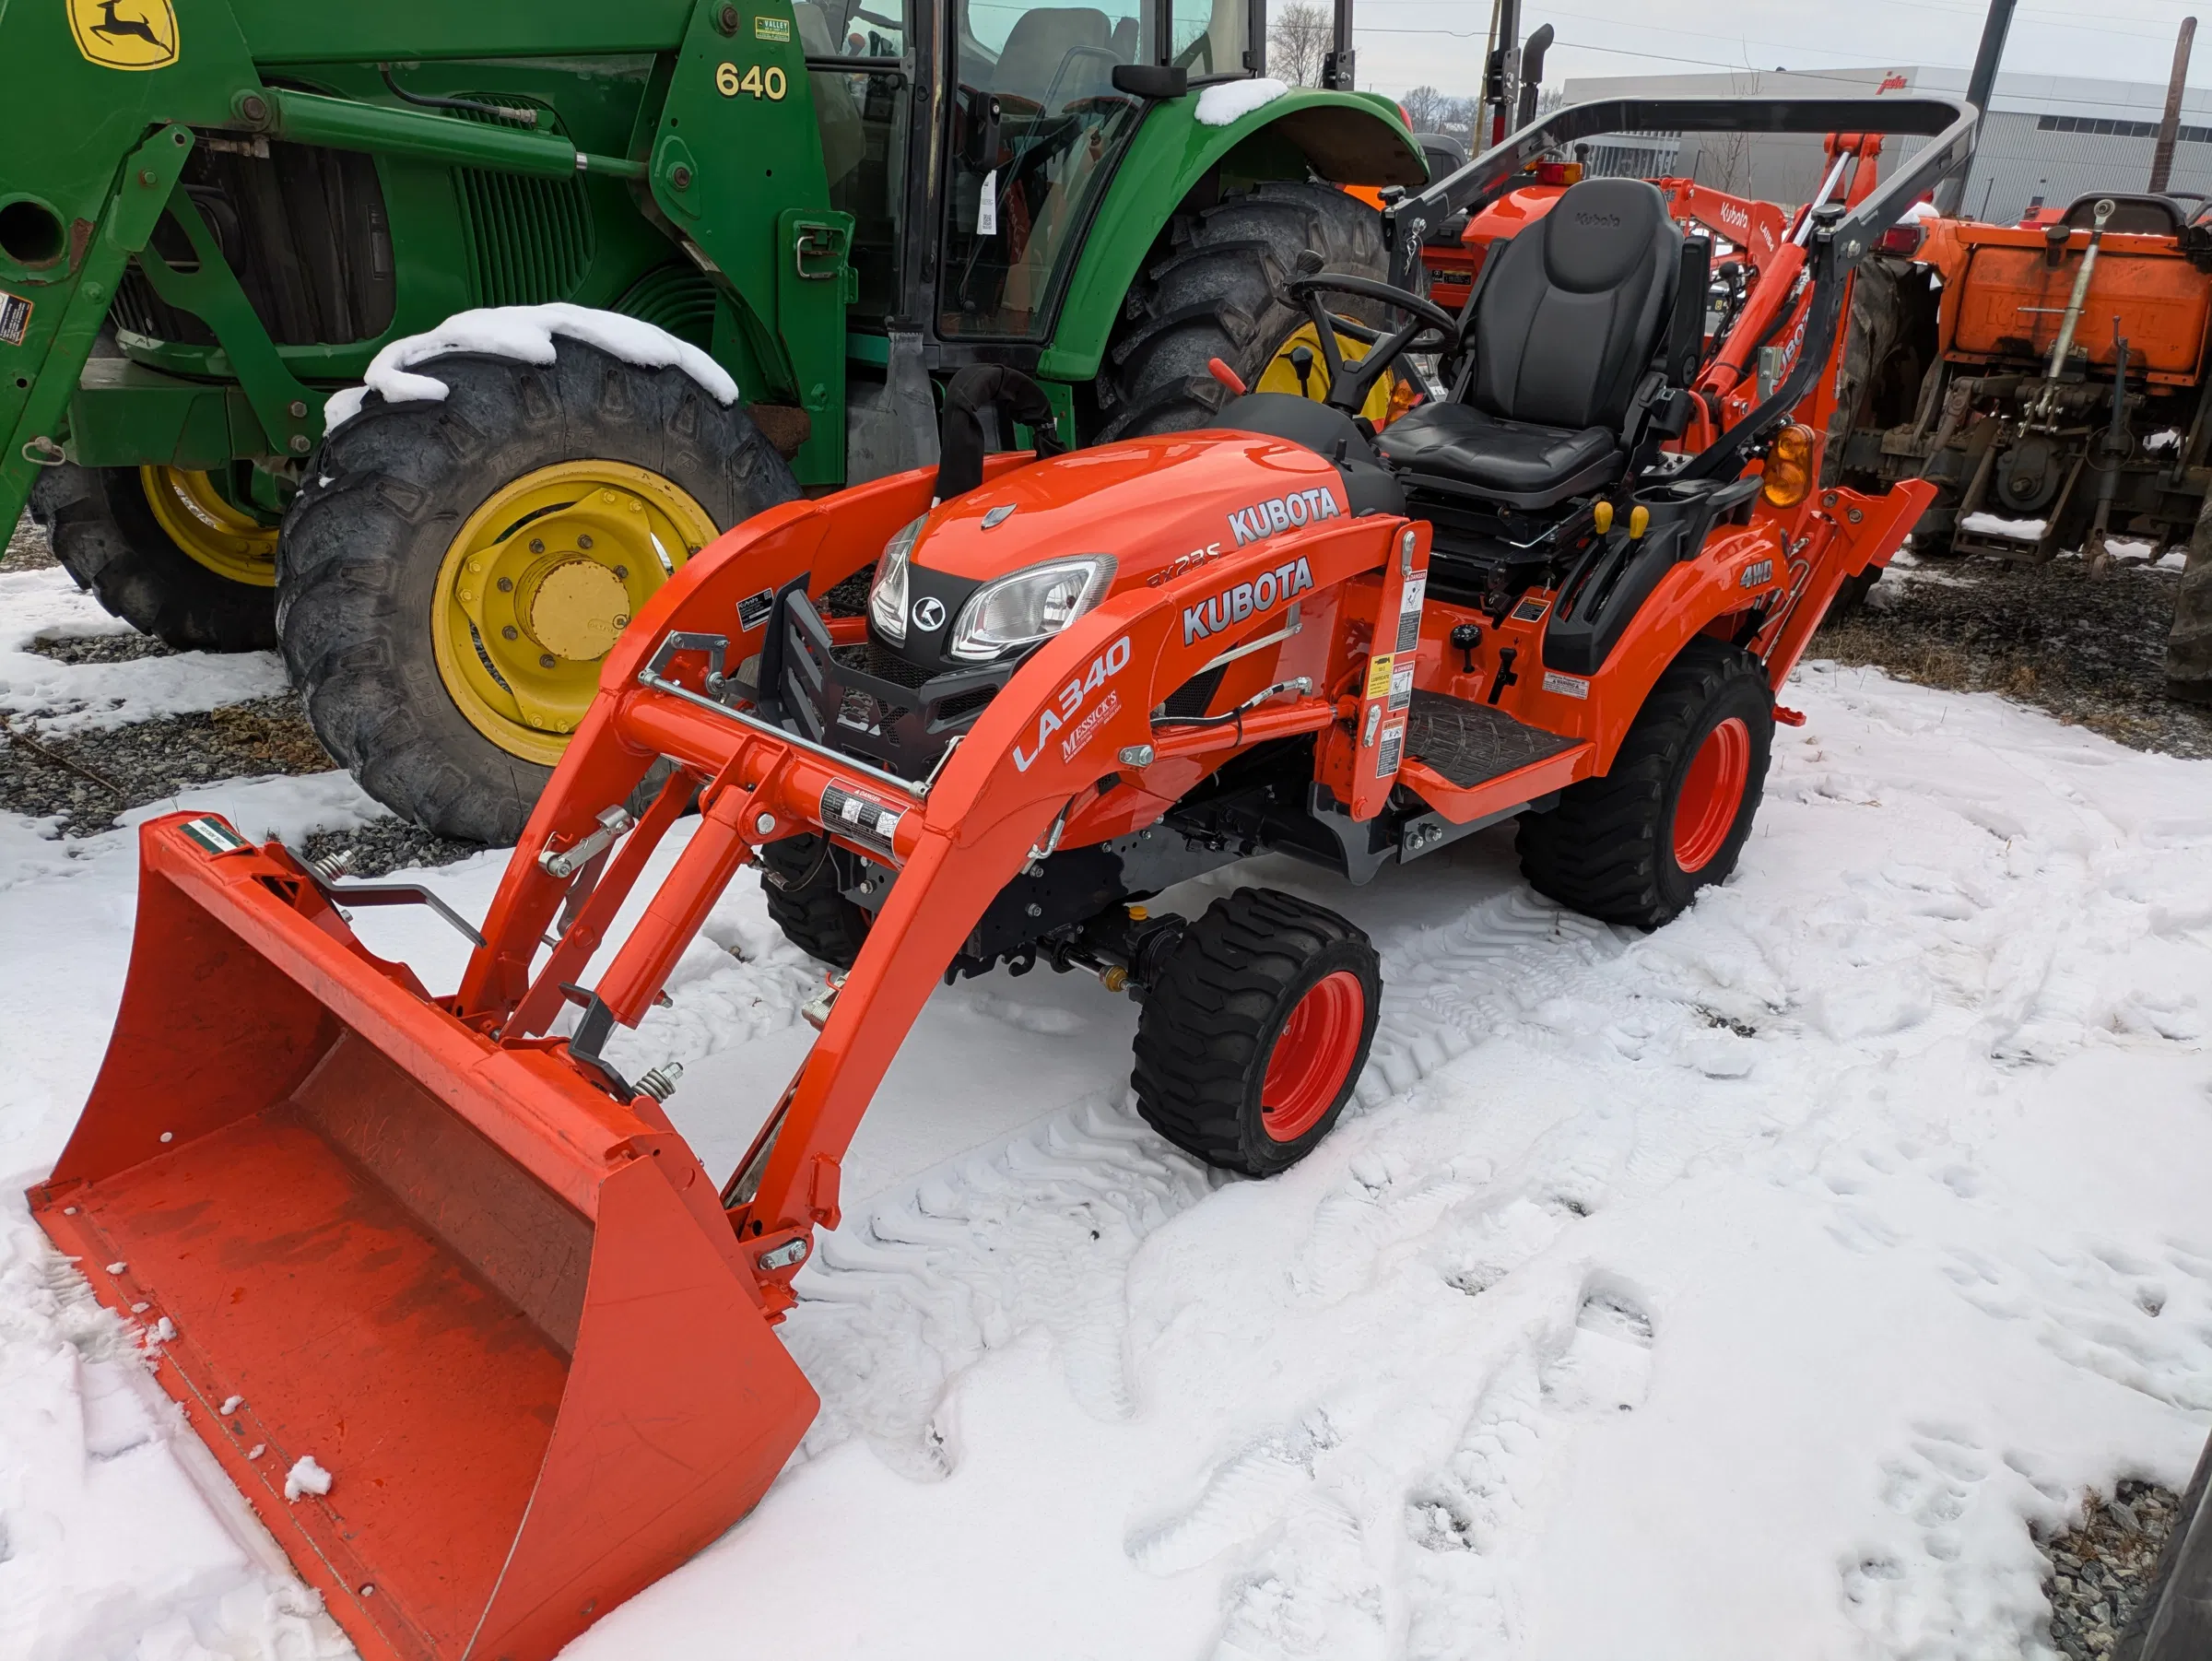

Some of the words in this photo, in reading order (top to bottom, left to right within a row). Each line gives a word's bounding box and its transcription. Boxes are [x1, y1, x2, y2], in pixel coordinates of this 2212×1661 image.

[764, 20, 787, 29] VALLEY
[715, 61, 787, 100] 640
[1575, 211, 1621, 229] Kubota
[1720, 201, 1749, 230] Kubota
[1228, 486, 1341, 547] KUBOTA
[1739, 559, 1773, 589] 4WD
[1182, 555, 1315, 647] KUBOTA
[836, 686, 910, 748] BX
[1012, 635, 1131, 772] LA340
[1061, 689, 1118, 760] MESSICK'S
[859, 790, 882, 803] DANGER
